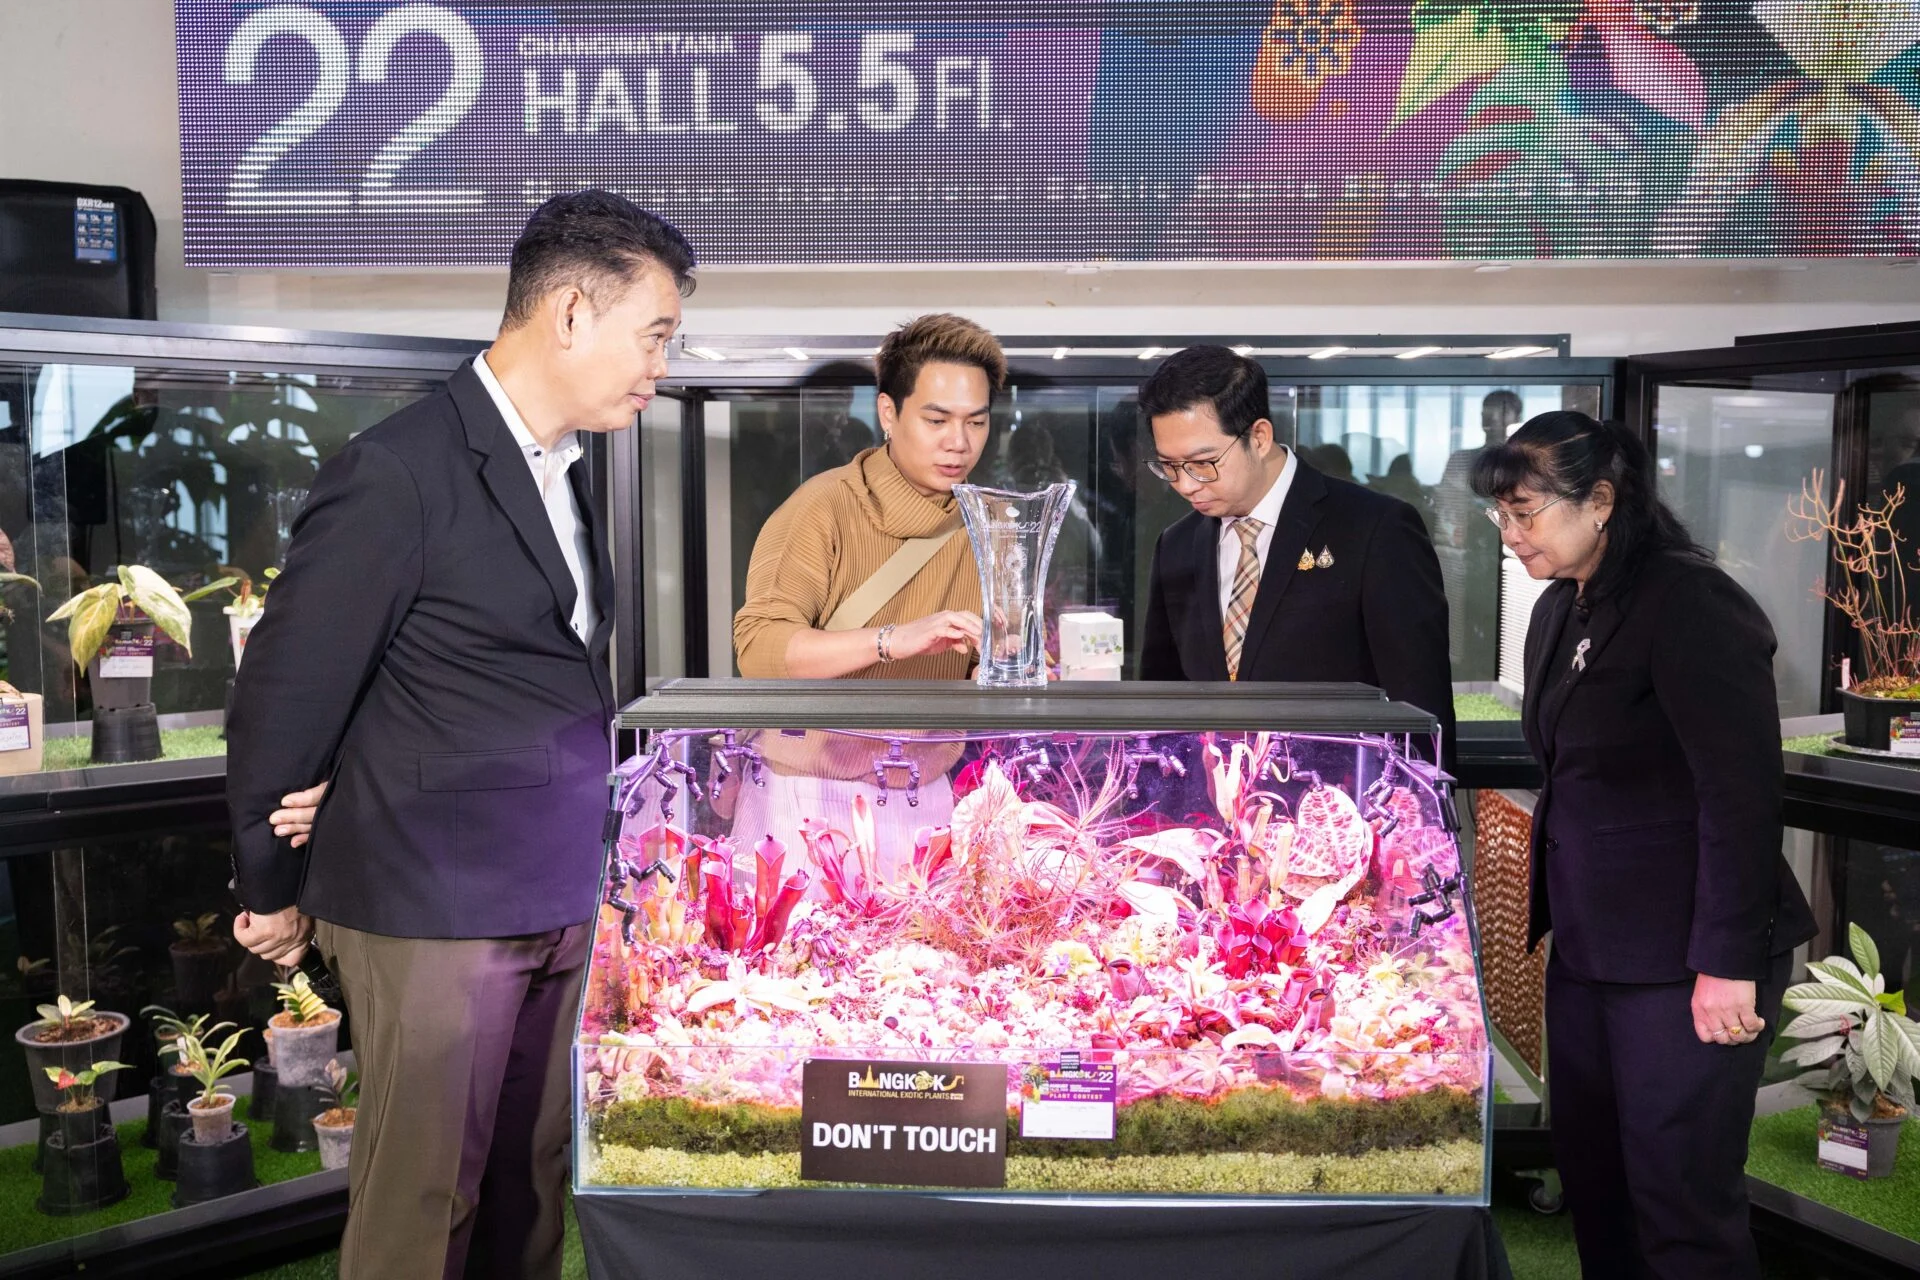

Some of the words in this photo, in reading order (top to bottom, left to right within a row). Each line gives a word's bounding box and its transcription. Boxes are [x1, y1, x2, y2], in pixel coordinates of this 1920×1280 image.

[223, 4, 485, 212] 22
[524, 68, 739, 132] HALL
[15, 707, 26, 716] 22
[1098, 1071, 1114, 1083] 22
[848, 1090, 899, 1098] INTERNATIONAL
[900, 1091, 924, 1099] EXOTIC
[924, 1092, 950, 1100] PLANTS
[812, 1122, 897, 1150] DON'T
[902, 1125, 997, 1153] TOUCH
